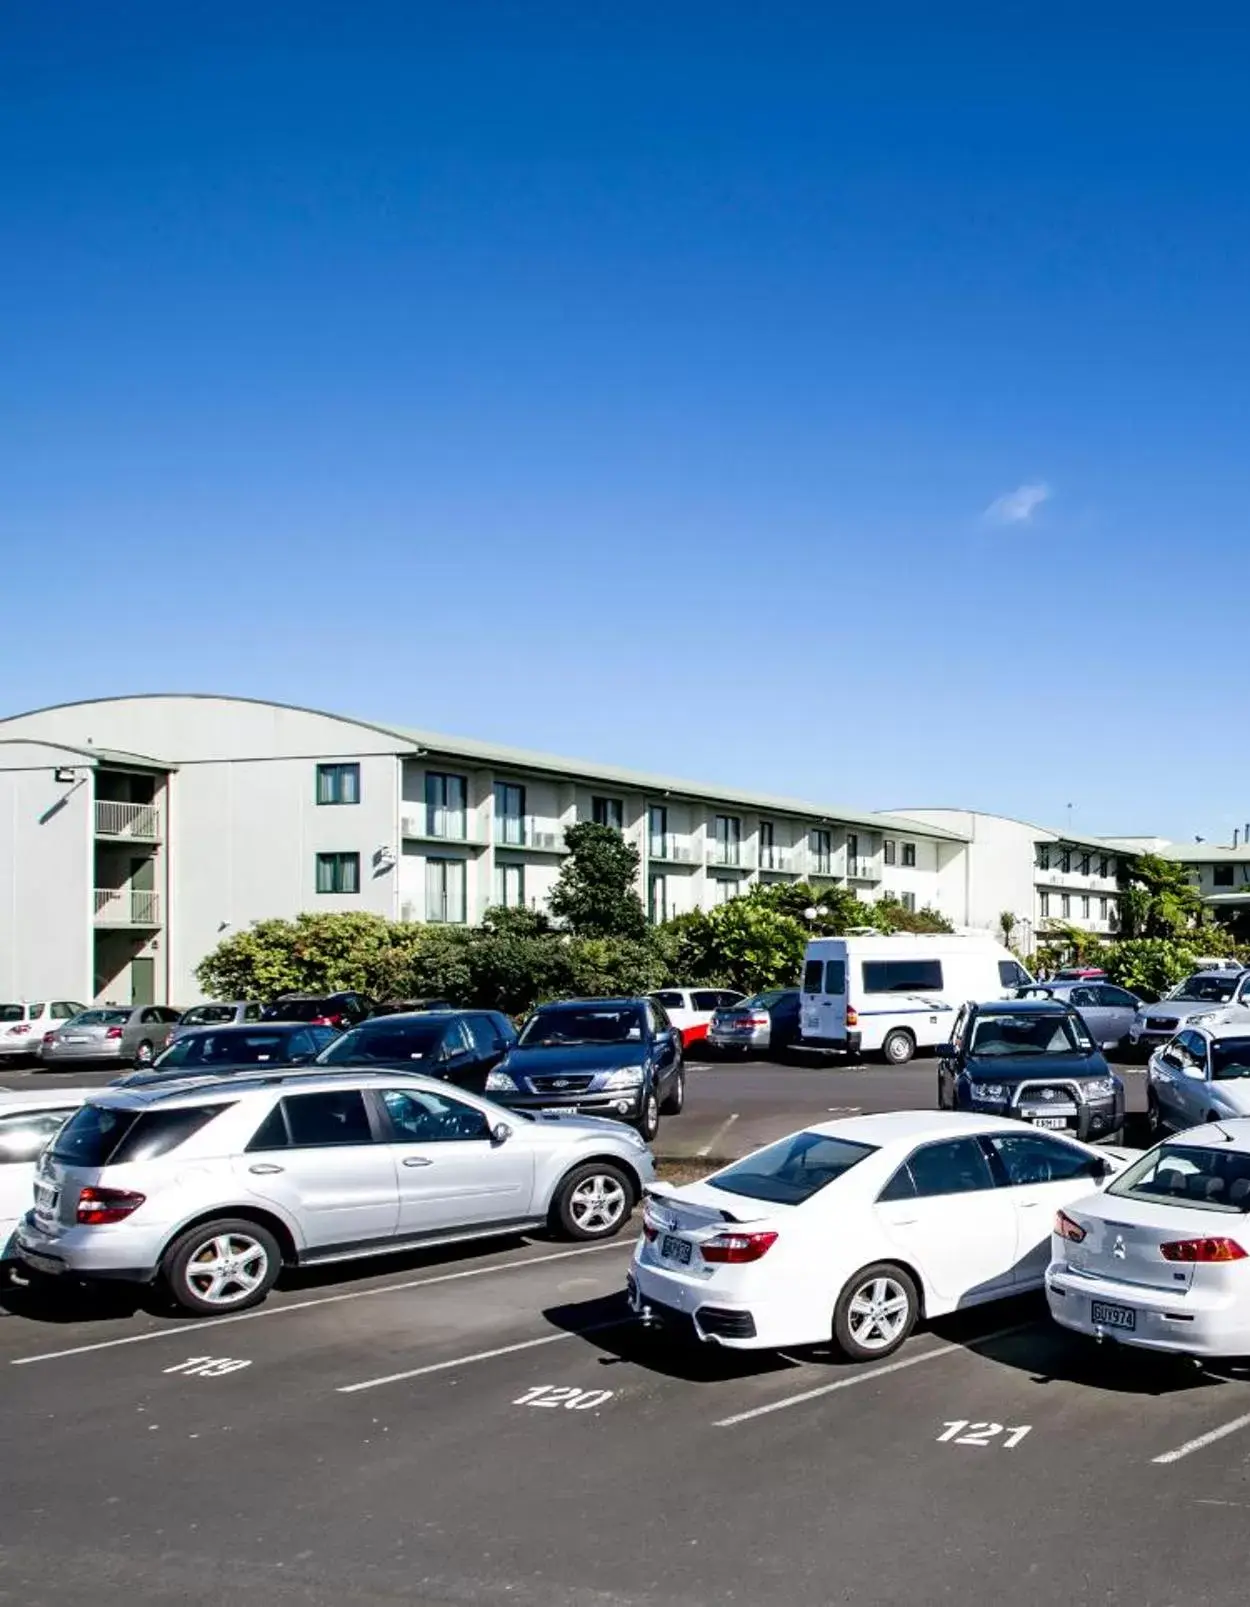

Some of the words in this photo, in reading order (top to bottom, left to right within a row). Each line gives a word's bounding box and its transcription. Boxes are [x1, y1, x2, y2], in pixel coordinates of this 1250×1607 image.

[1094, 1304, 1133, 1327] GUY974
[162, 1356, 252, 1376] 119
[511, 1385, 614, 1409] 120
[936, 1420, 1032, 1447] 121
